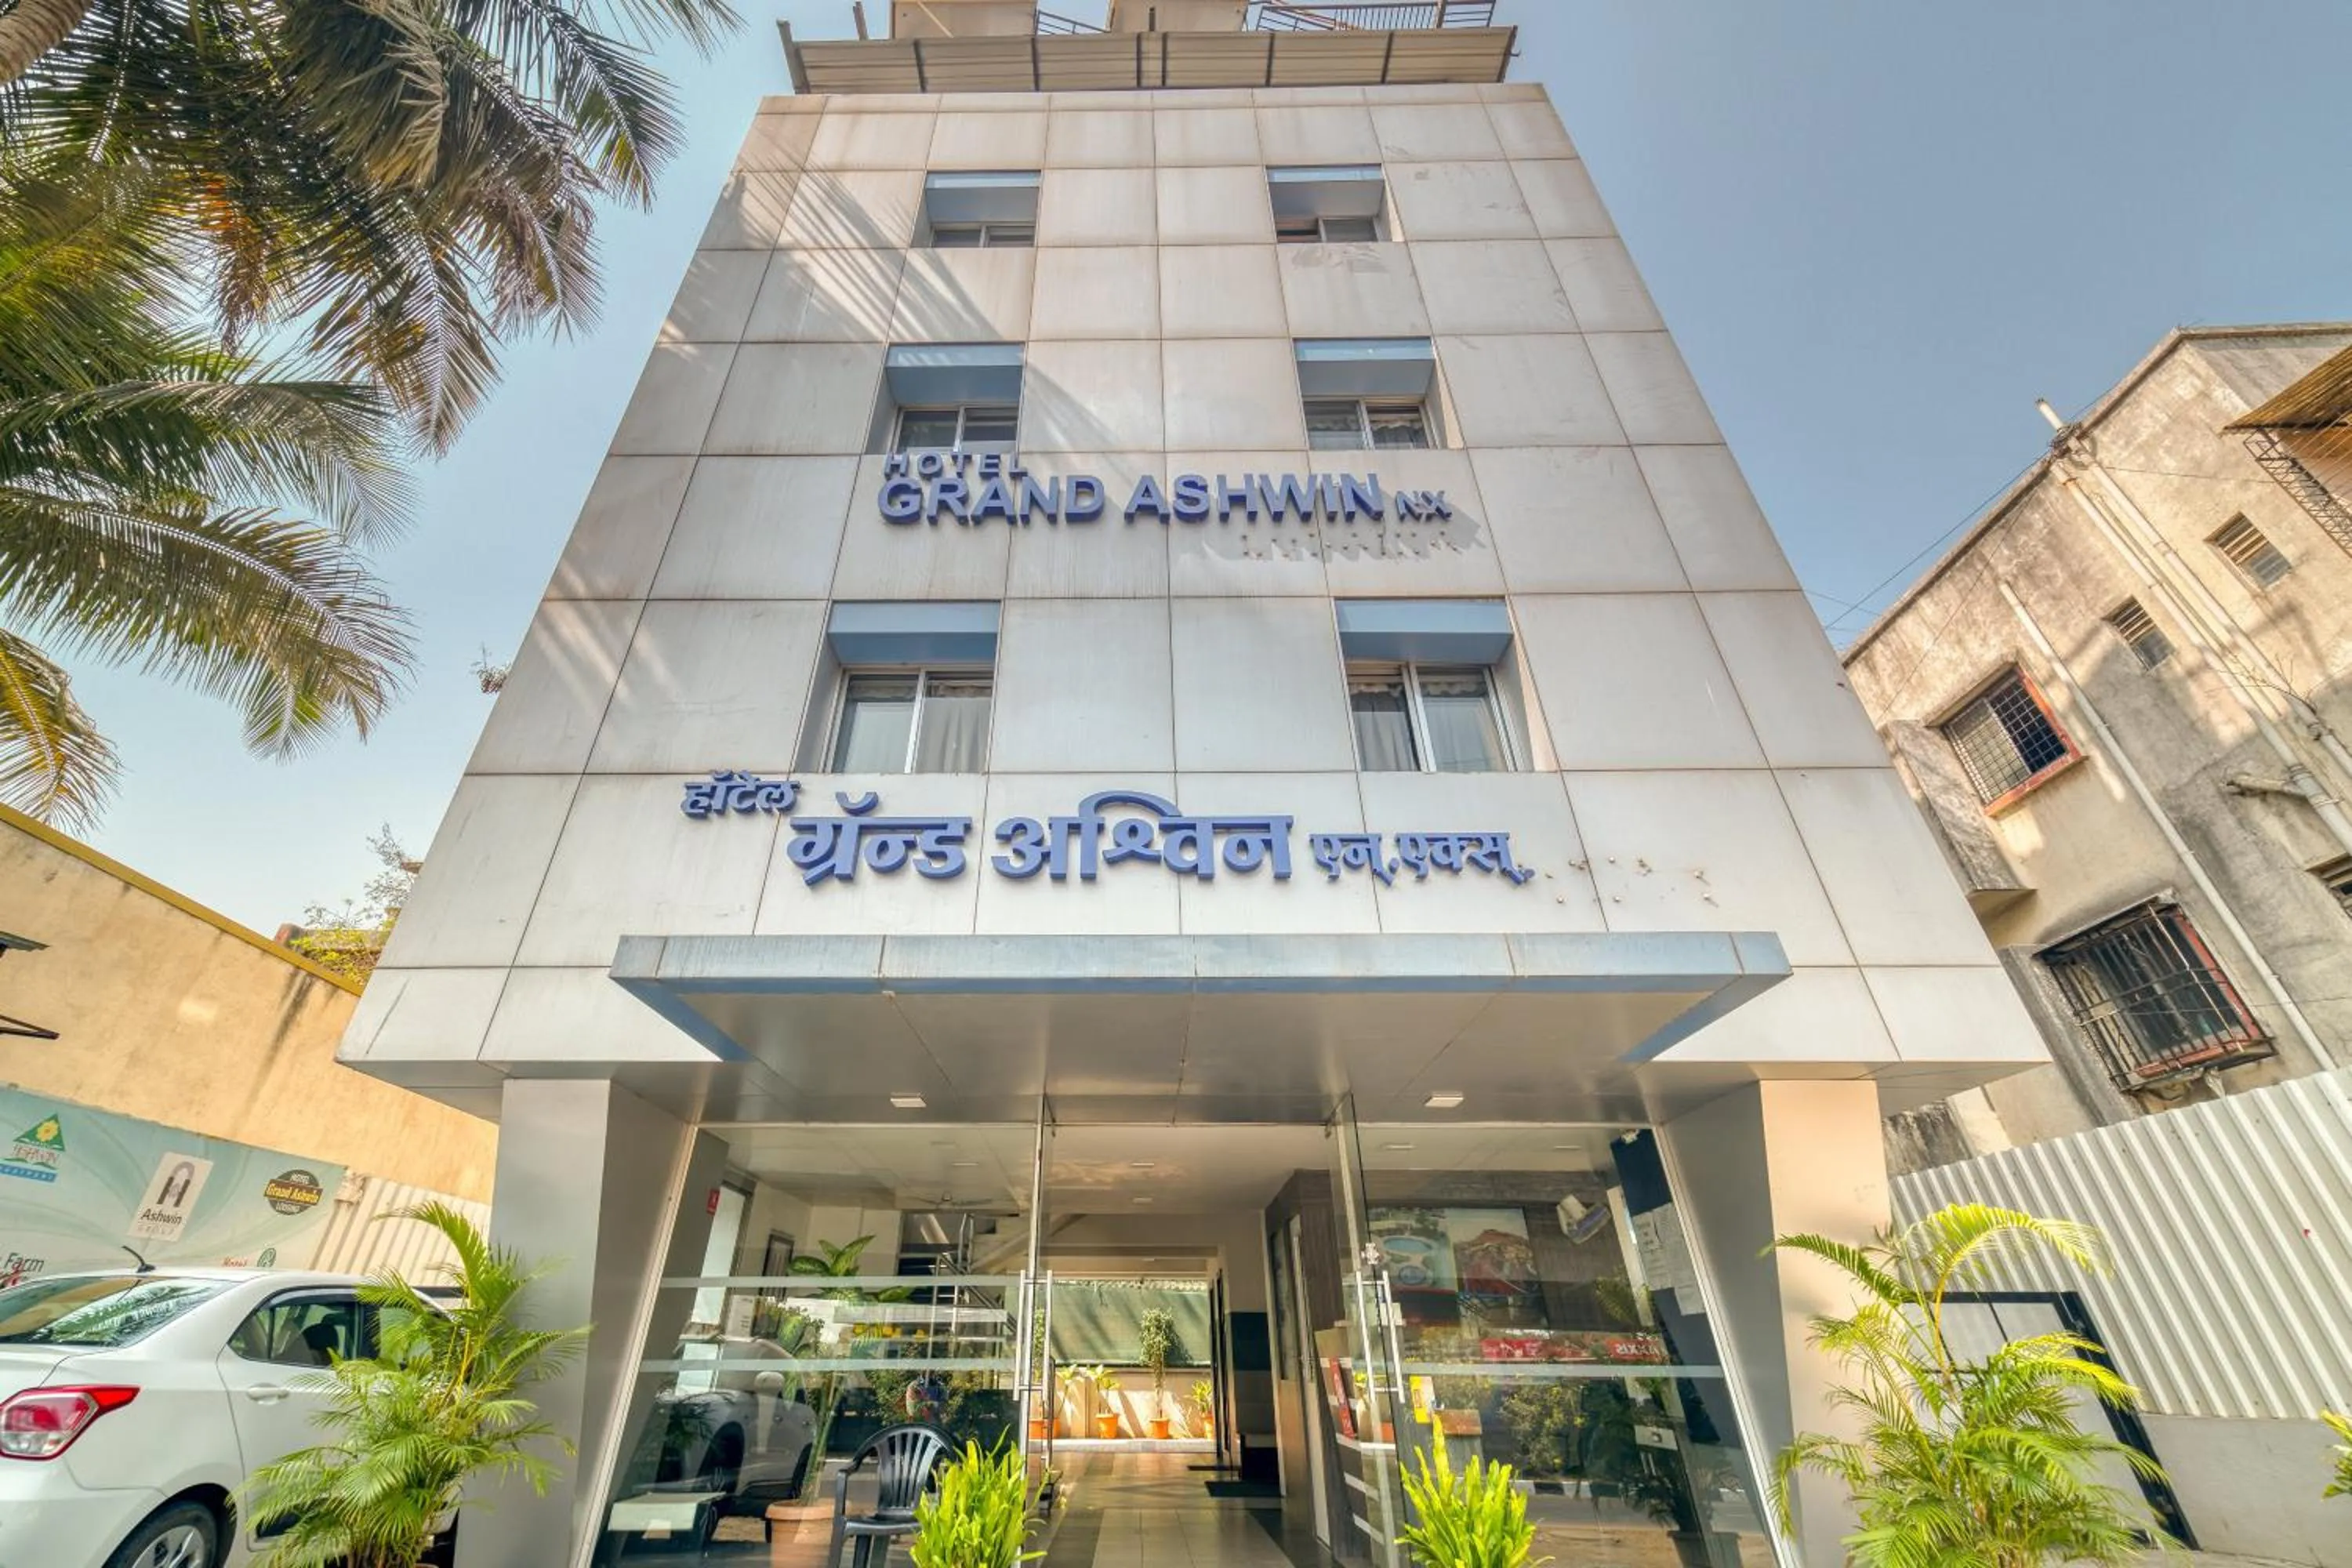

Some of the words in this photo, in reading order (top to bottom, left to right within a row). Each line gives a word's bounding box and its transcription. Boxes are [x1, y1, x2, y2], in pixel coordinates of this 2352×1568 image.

[884, 451, 1028, 480] HOTEL
[878, 475, 1105, 525] GRAND
[1124, 473, 1385, 524] ASHWIN
[1395, 489, 1452, 521] NX
[681, 769, 801, 818] हॉटेल
[991, 789, 1294, 880] अश्विन
[141, 1208, 182, 1225] Ashwin
